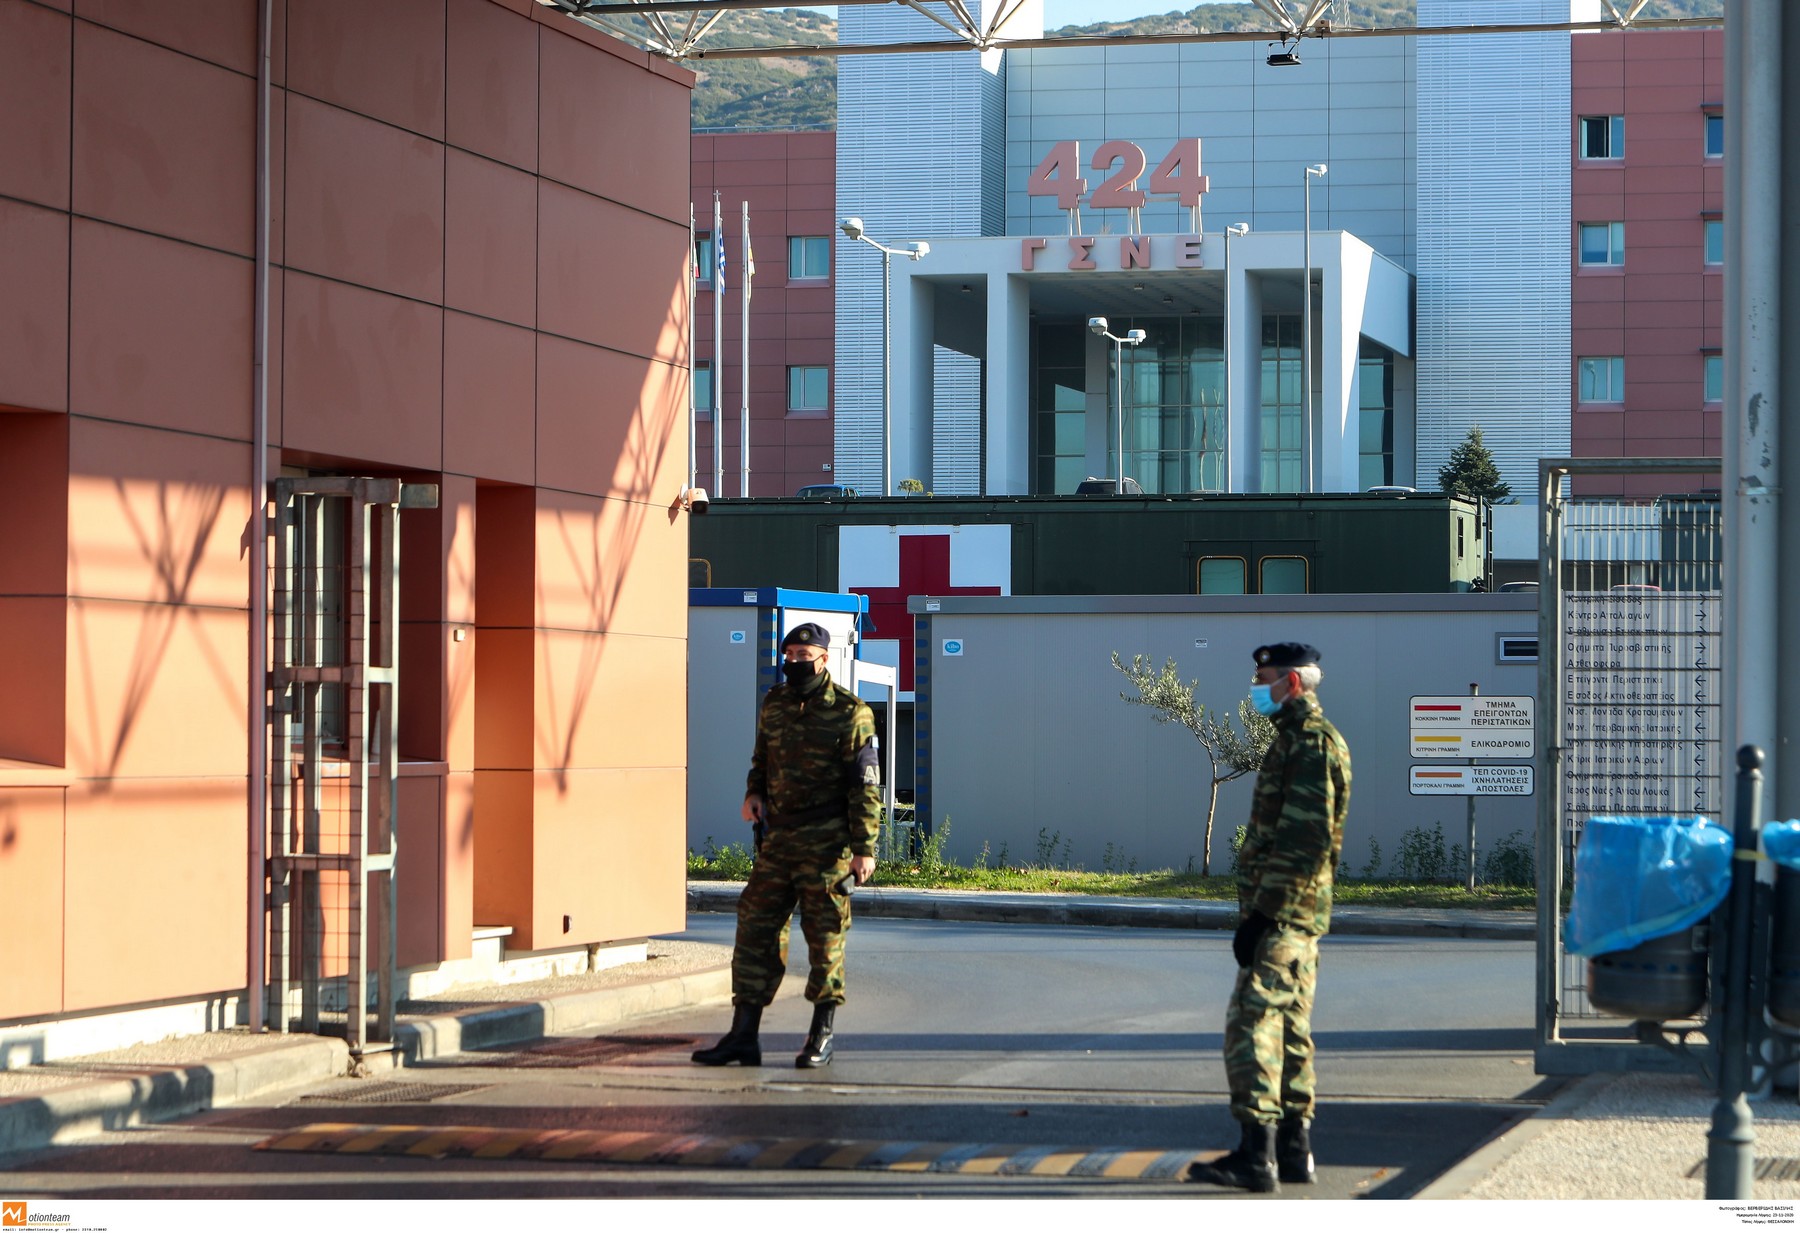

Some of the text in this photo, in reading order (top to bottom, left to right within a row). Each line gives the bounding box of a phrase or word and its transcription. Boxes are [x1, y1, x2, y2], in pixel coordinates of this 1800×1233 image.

[1028, 138, 1210, 209] 424
[1567, 643, 1604, 654] Οχήμτα
[1567, 690, 1602, 702] Εσοδος
